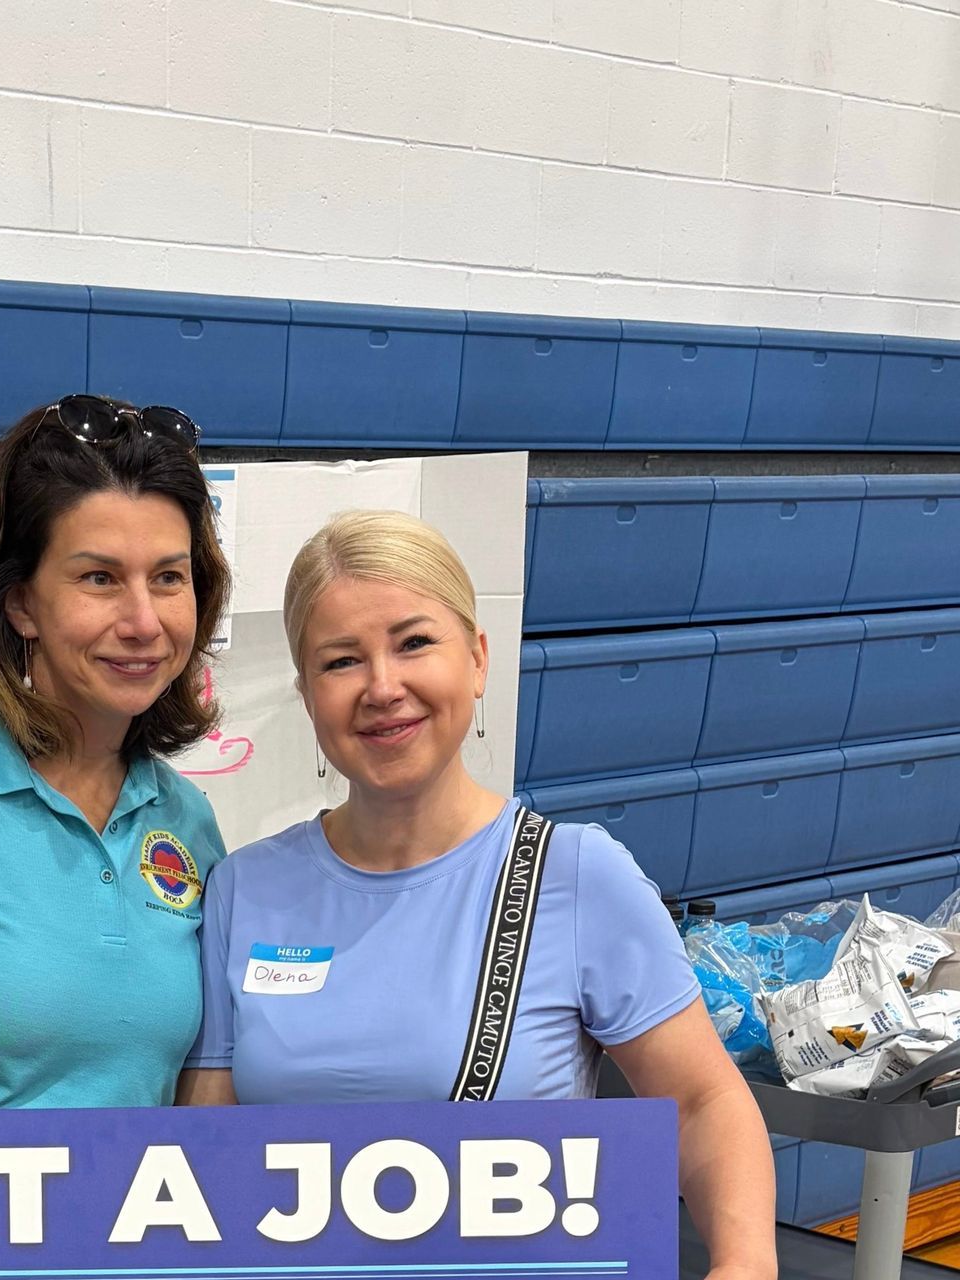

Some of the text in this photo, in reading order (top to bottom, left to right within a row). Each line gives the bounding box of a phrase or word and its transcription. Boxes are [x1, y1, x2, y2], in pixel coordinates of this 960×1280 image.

[152, 832, 170, 840] KIDS
[503, 845, 534, 924] CAMUTO
[254, 966, 318, 982] Olena
[276, 947, 311, 957] HELLO
[492, 930, 519, 988] VINCE
[473, 991, 506, 1078] CAMUTO
[108, 1144, 222, 1243] A
[256, 1137, 600, 1243] JOB!
